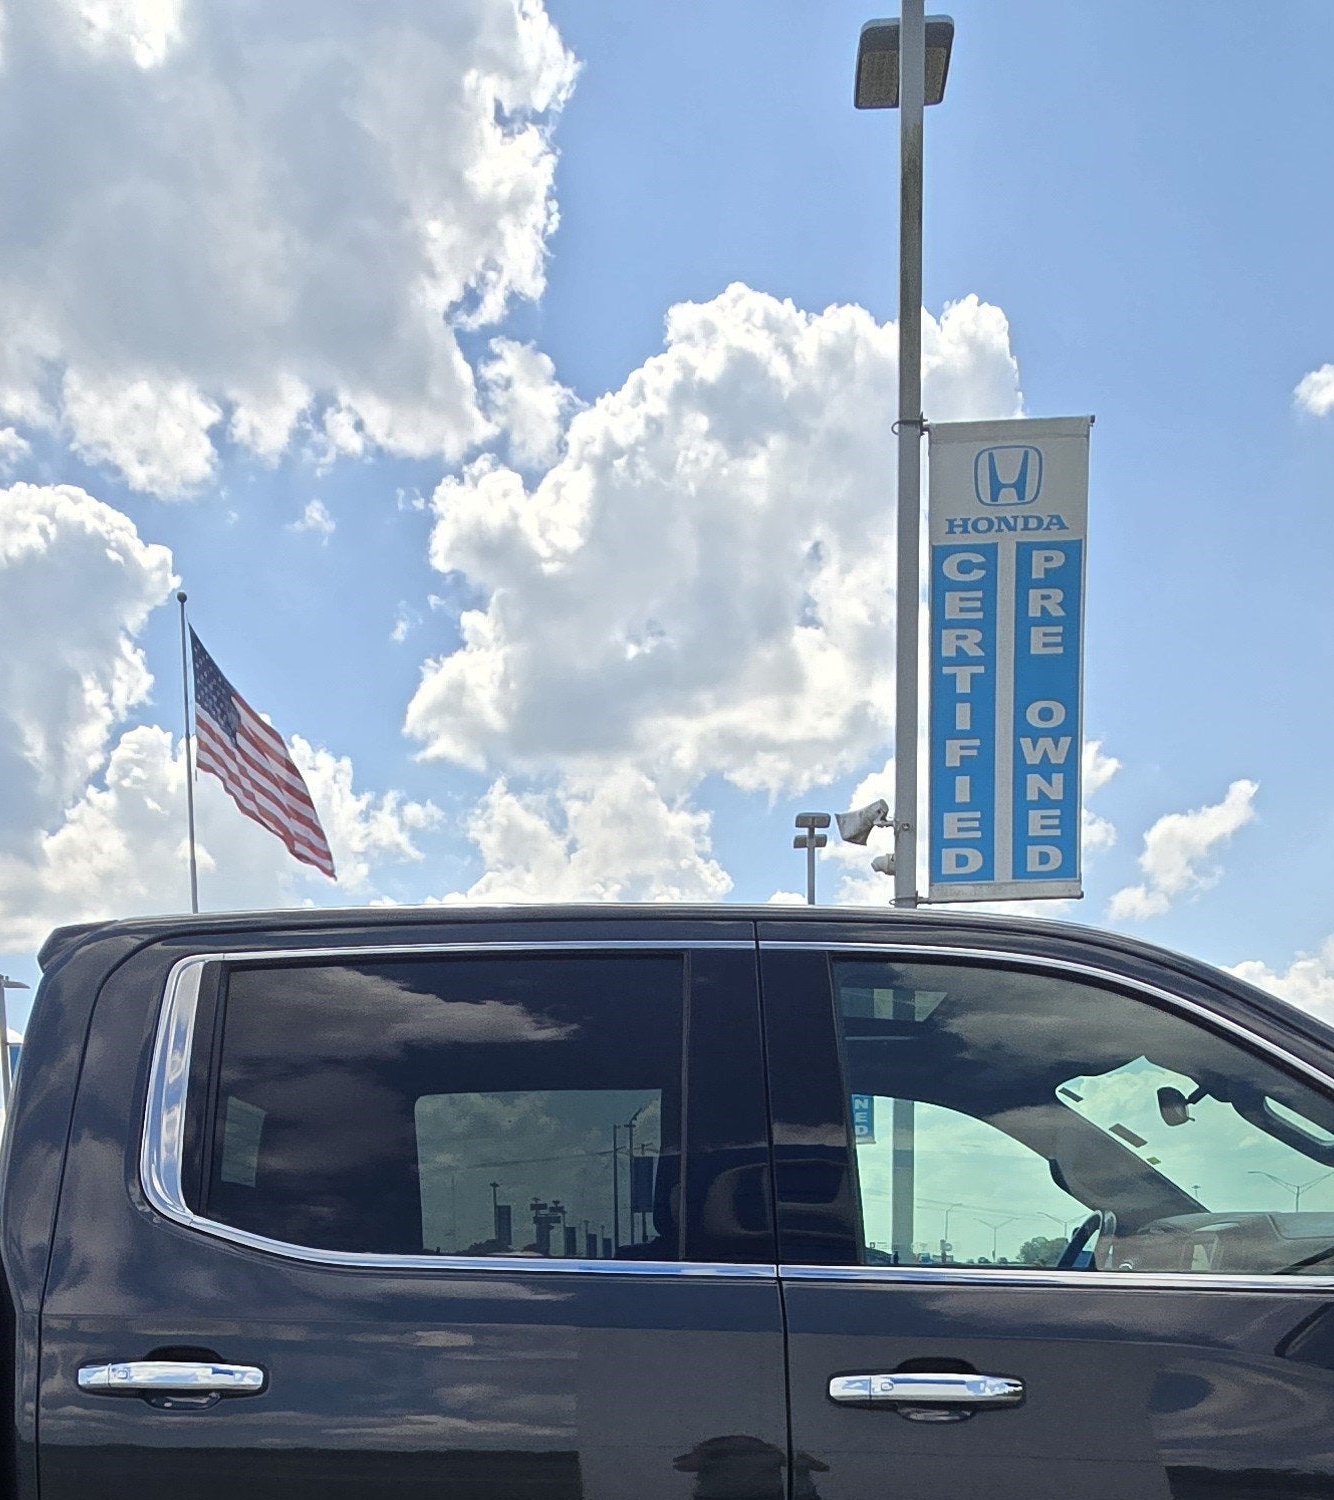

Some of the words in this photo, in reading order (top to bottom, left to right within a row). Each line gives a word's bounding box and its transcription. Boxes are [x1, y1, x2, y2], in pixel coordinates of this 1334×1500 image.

[944, 514, 1070, 536] HONDA
[1027, 549, 1066, 656] PRE
[940, 551, 988, 877] CERTIFIED
[1019, 700, 1072, 873] OWNED
[854, 1098, 869, 1136] NED
